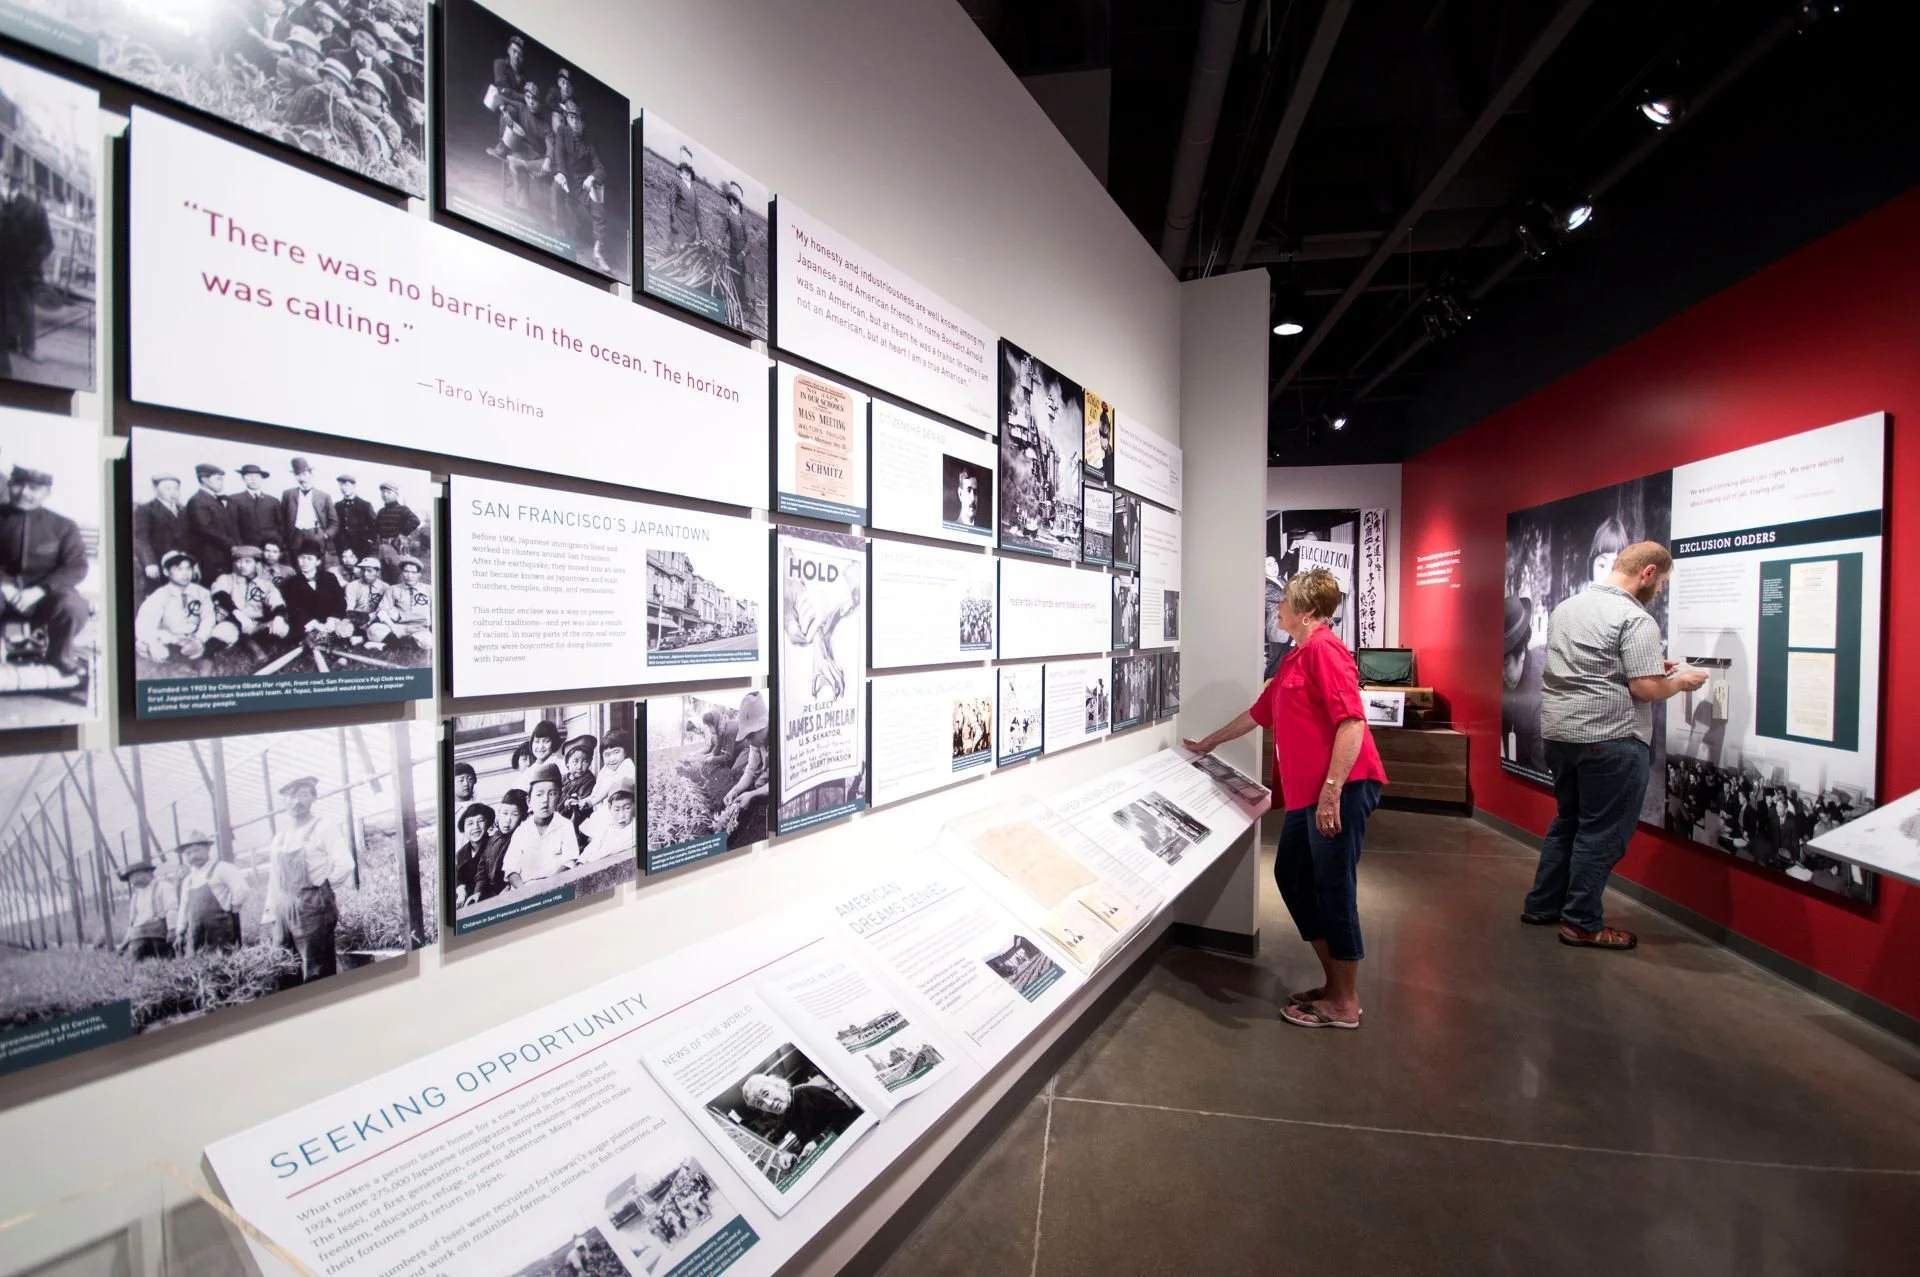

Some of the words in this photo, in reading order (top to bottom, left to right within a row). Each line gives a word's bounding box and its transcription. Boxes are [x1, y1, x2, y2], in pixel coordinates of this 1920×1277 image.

[184, 201, 305, 264] "There
[318, 254, 377, 287] was
[389, 277, 420, 300] no
[432, 285, 518, 331] barrier
[526, 316, 544, 341] in
[552, 328, 583, 352] the
[590, 344, 647, 374] ocean.
[652, 360, 682, 384] The
[687, 371, 739, 403] horizon
[202, 272, 272, 307] was
[286, 297, 413, 345] calling."
[796, 252, 836, 283] Japanese
[838, 278, 853, 292] and
[854, 284, 889, 311] American
[890, 304, 915, 326] friends.
[917, 320, 922, 329] In
[924, 325, 940, 340] name
[941, 332, 965, 352] Benedict
[966, 347, 983, 364] Arnold
[796, 276, 814, 292] was
[816, 286, 826, 298] an
[828, 291, 868, 321] American,
[869, 312, 881, 326] but
[882, 322, 890, 331] at
[891, 324, 909, 341] heart
[910, 334, 918, 346] he
[919, 342, 931, 352] was
[810, 237, 843, 267] honesty
[844, 260, 858, 275] and
[860, 267, 914, 307] industriousness
[916, 302, 926, 314] are
[927, 309, 940, 322] well
[940, 315, 958, 332] known
[960, 328, 977, 346] among
[977, 339, 985, 350] my
[797, 296, 811, 310] not
[813, 305, 824, 317] an
[826, 309, 865, 338] American,
[867, 329, 879, 344] but
[880, 338, 887, 348] at
[888, 340, 906, 357] heart
[912, 354, 921, 364] am
[417, 378, 473, 401] —Taro
[478, 389, 544, 418] Yashima
[798, 407, 816, 422] MASS
[819, 414, 846, 431] MEETING
[807, 394, 819, 404] OUR
[805, 461, 843, 479] SCHMITZ
[472, 500, 510, 519] SAN
[632, 520, 710, 541] JAPANTOWN
[1680, 538, 1731, 553] EXCLUSION
[1734, 532, 1776, 546] ORDERS
[789, 558, 838, 582] HOLD
[1301, 546, 1350, 569] EVACUATION
[786, 715, 814, 742] JAMES
[816, 713, 823, 731] D.
[798, 736, 810, 746] U.S.
[812, 729, 841, 742] SENATOR
[462, 918, 482, 929] Children
[835, 882, 902, 918] AMERICAN
[849, 902, 905, 935] DREAMS
[902, 882, 947, 908] DENIED
[662, 1046, 690, 1067] NEWS
[690, 1038, 702, 1050] OF
[702, 1024, 723, 1041] THE
[720, 1005, 752, 1029] WORLD
[270, 1086, 446, 1179] SEEKING
[456, 993, 647, 1092] OPPORTUNITY
[296, 1202, 331, 1221] What
[333, 1183, 371, 1205] makes
[382, 1158, 418, 1182] person
[418, 1144, 445, 1161] leave
[446, 1129, 474, 1147] home
[475, 1122, 489, 1132] for
[498, 1108, 516, 1120] new
[517, 1094, 539, 1111] land?
[540, 1079, 576, 1098] Between
[594, 1060, 608, 1072] and
[305, 1216, 337, 1235] 1924,
[338, 1199, 368, 1218] some
[370, 1176, 411, 1201] 275,000
[411, 1153, 456, 1182] Japanese
[458, 1125, 511, 1156] immigrants
[512, 1107, 542, 1128] arrived
[552, 1096, 567, 1106] the
[566, 1080, 593, 1098] United
[312, 1232, 335, 1247] The
[337, 1216, 368, 1235] Issei,
[369, 1208, 381, 1218] or
[383, 1194, 406, 1211] first
[408, 1166, 465, 1200] generation,
[465, 1150, 490, 1166] came
[491, 1141, 505, 1152] for
[506, 1127, 532, 1144] many
[318, 1232, 373, 1262] freedom,
[373, 1200, 432, 1232] education,
[432, 1180, 468, 1200] refuge,
[467, 1171, 478, 1180] or
[480, 1158, 502, 1173] even
[504, 1133, 546, 1160] adventure.
[548, 1119, 572, 1135] Many
[572, 1101, 602, 1121] wanted
[611, 1087, 631, 1100] make
[326, 1256, 355, 1275] their
[357, 1228, 406, 1258] fortunes
[408, 1212, 429, 1230] and
[430, 1196, 464, 1217] return
[464, 1188, 476, 1198] to
[476, 1172, 504, 1193] Japan.
